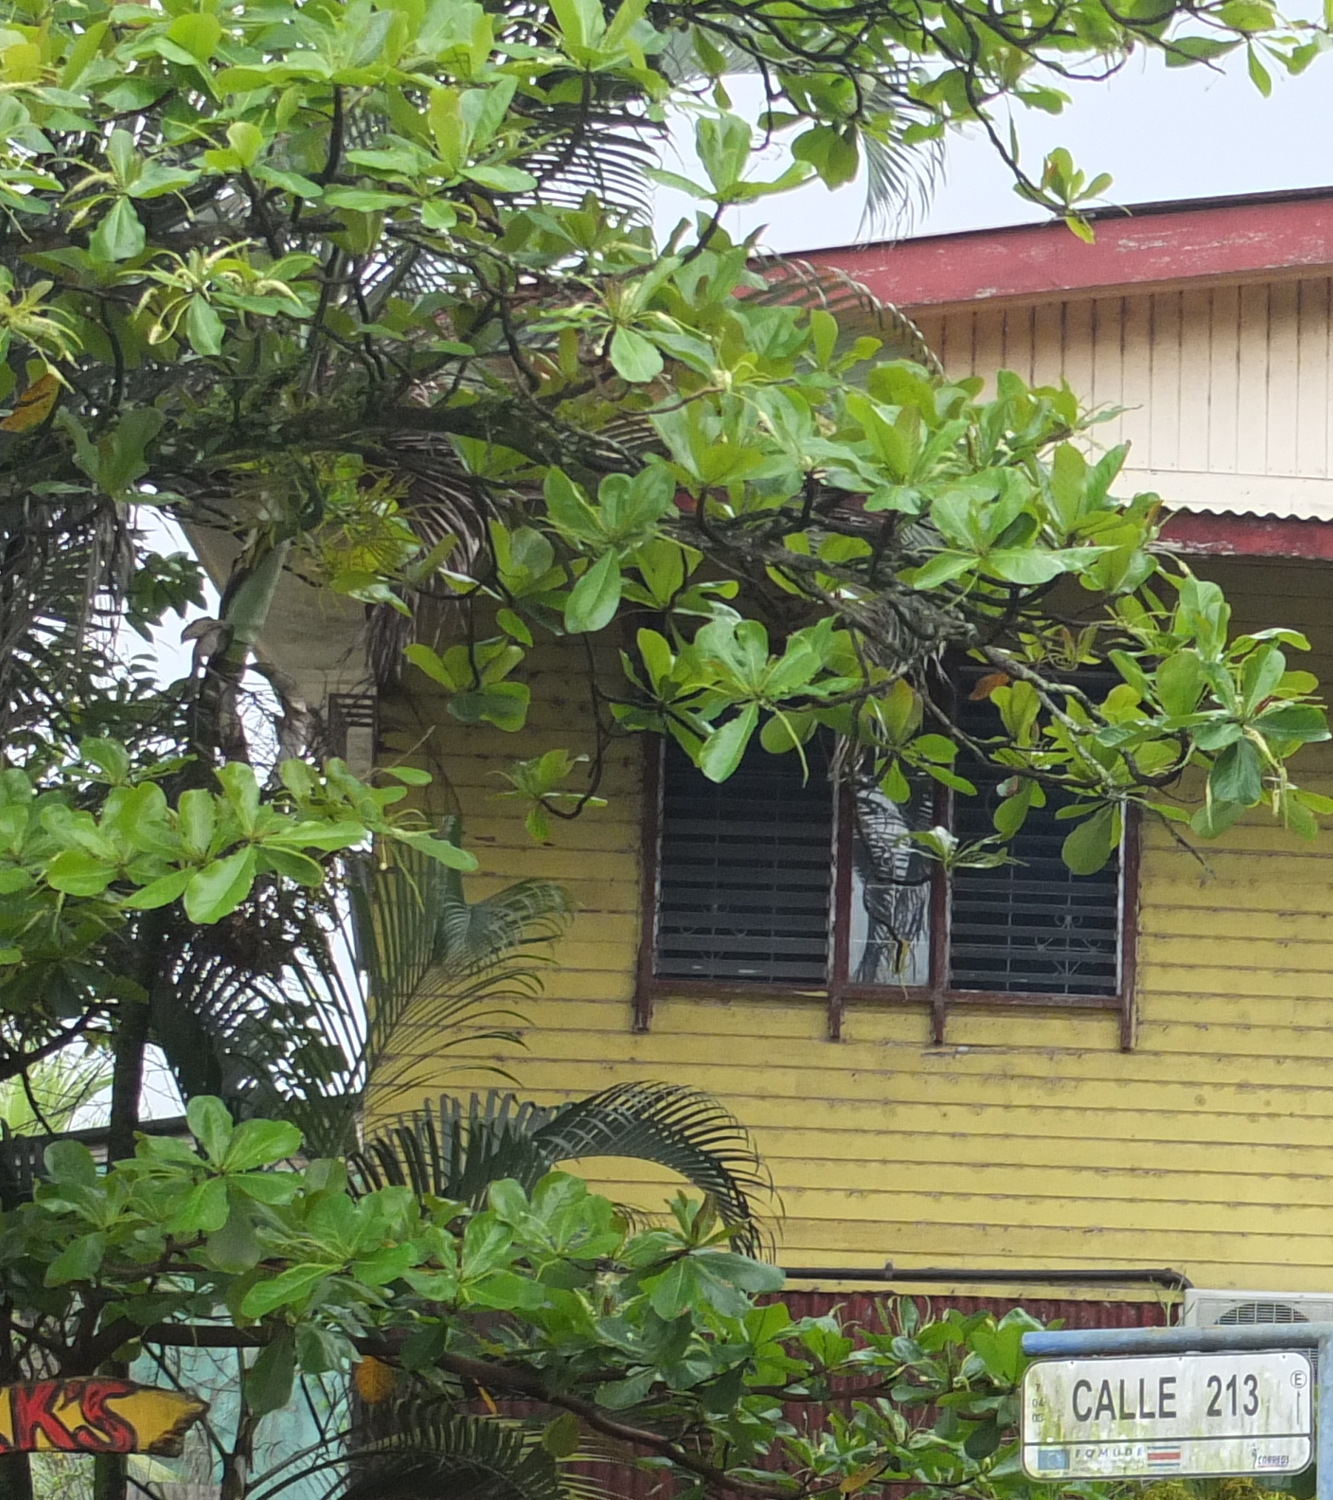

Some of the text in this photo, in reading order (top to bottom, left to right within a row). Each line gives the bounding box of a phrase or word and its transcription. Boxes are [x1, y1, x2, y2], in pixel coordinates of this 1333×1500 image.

[0, 1380, 134, 1452] K'S
[1072, 1374, 1259, 1422] CALLE 213
